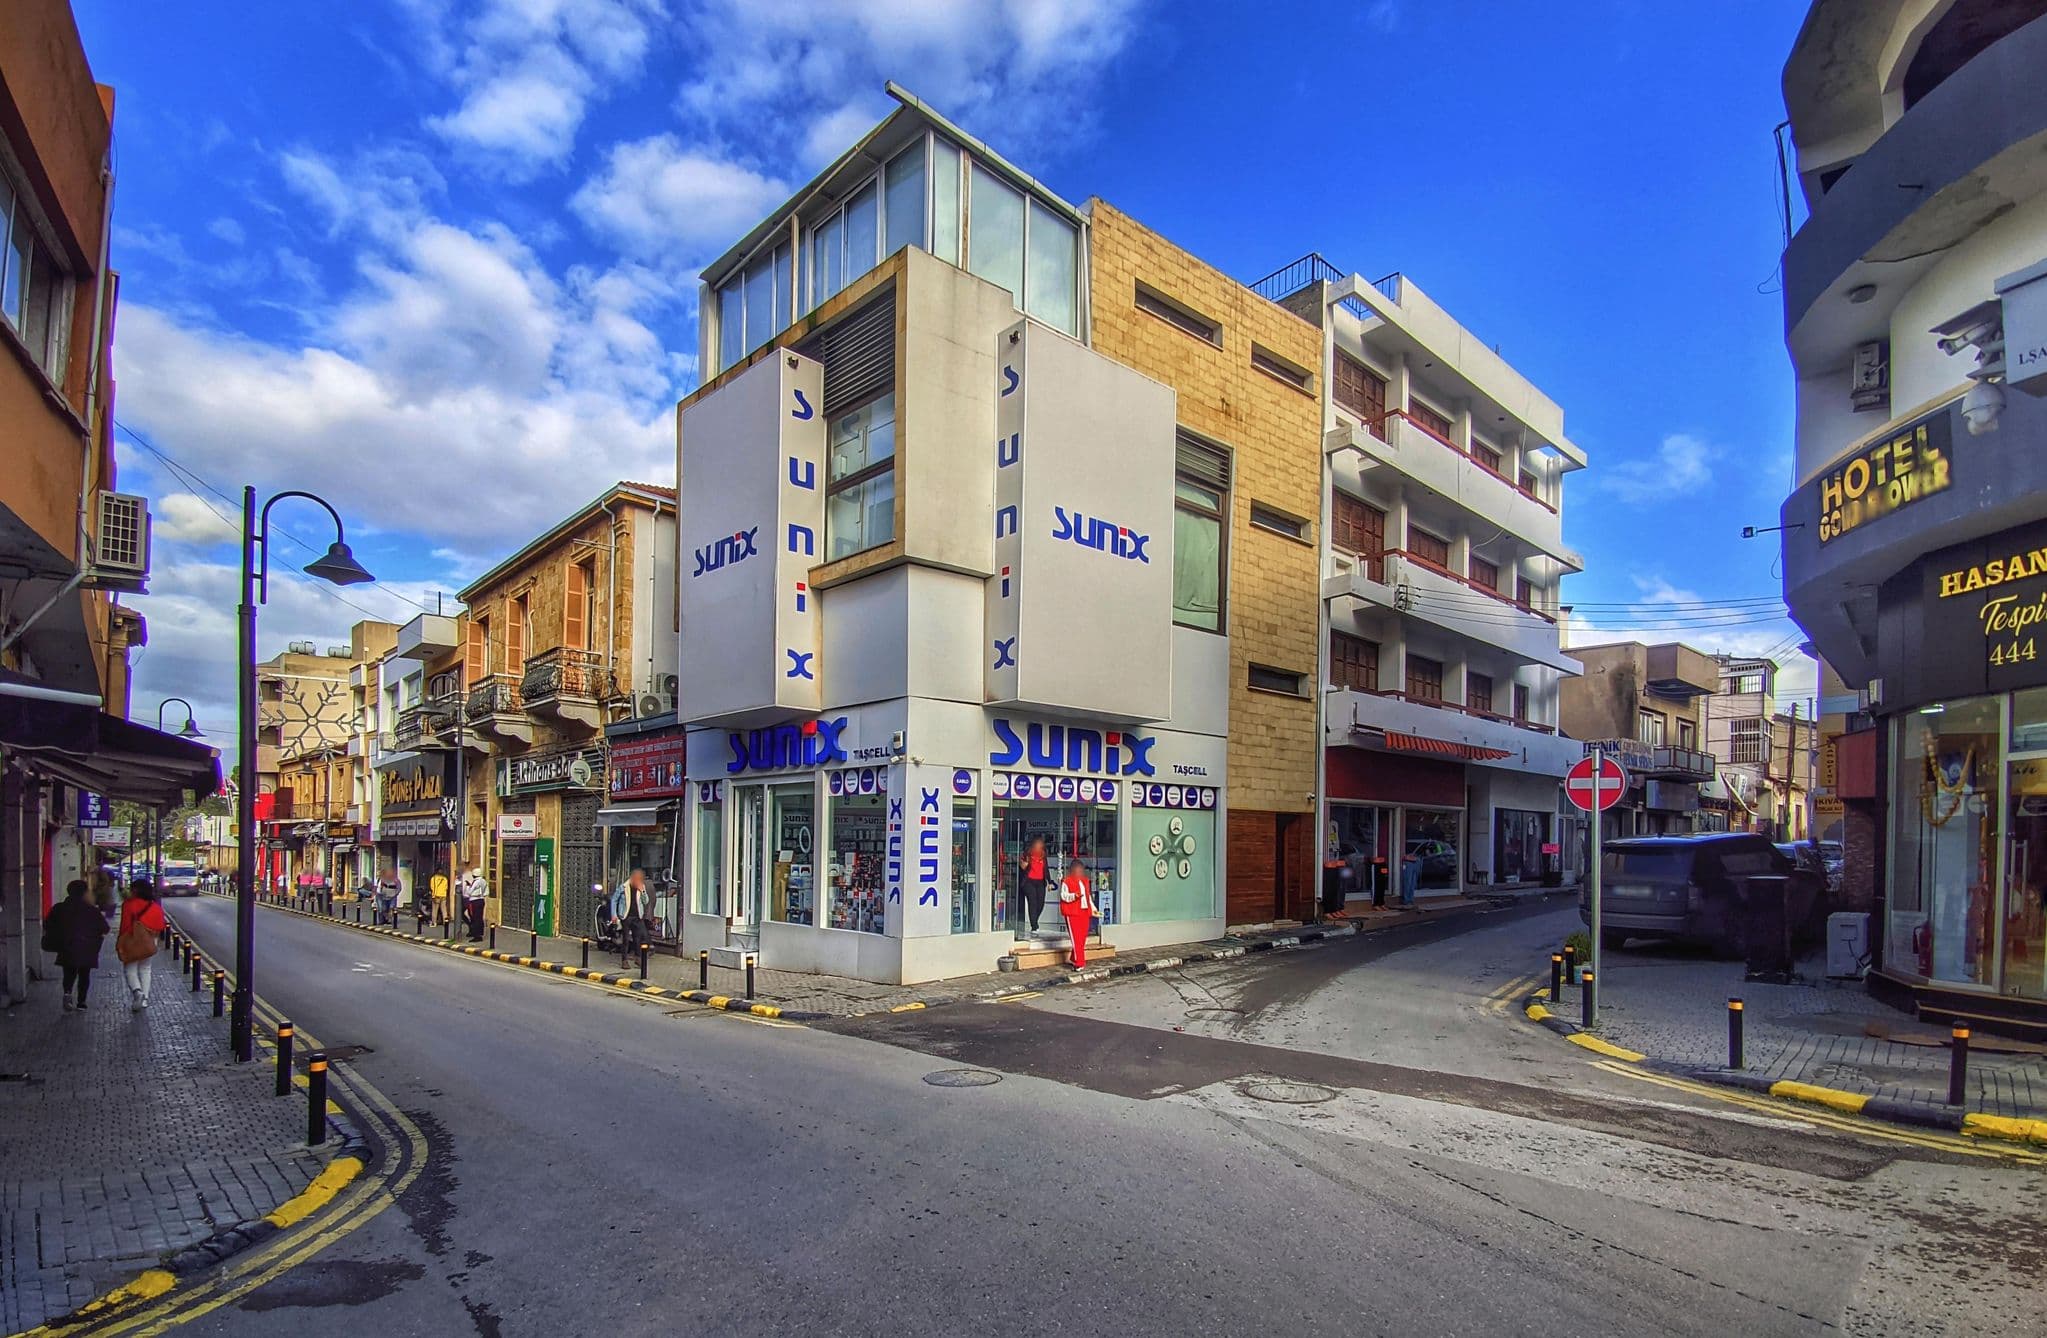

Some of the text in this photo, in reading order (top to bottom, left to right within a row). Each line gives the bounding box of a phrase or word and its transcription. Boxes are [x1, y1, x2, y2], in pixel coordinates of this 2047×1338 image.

[1821, 424, 1940, 514] HOTEL
[786, 389, 814, 680] sunix
[993, 365, 1019, 670] sunix
[1052, 506, 1150, 564] sunix
[693, 526, 758, 577] sunix
[1940, 548, 2047, 597] HASAN
[1980, 592, 2047, 637] Tespi
[1989, 638, 2037, 666] 444
[727, 717, 891, 773] sunix TAŞCELL
[990, 718, 1208, 777] sunix TAŞCELL
[888, 797, 902, 905] sunix
[919, 786, 940, 907] sunix
